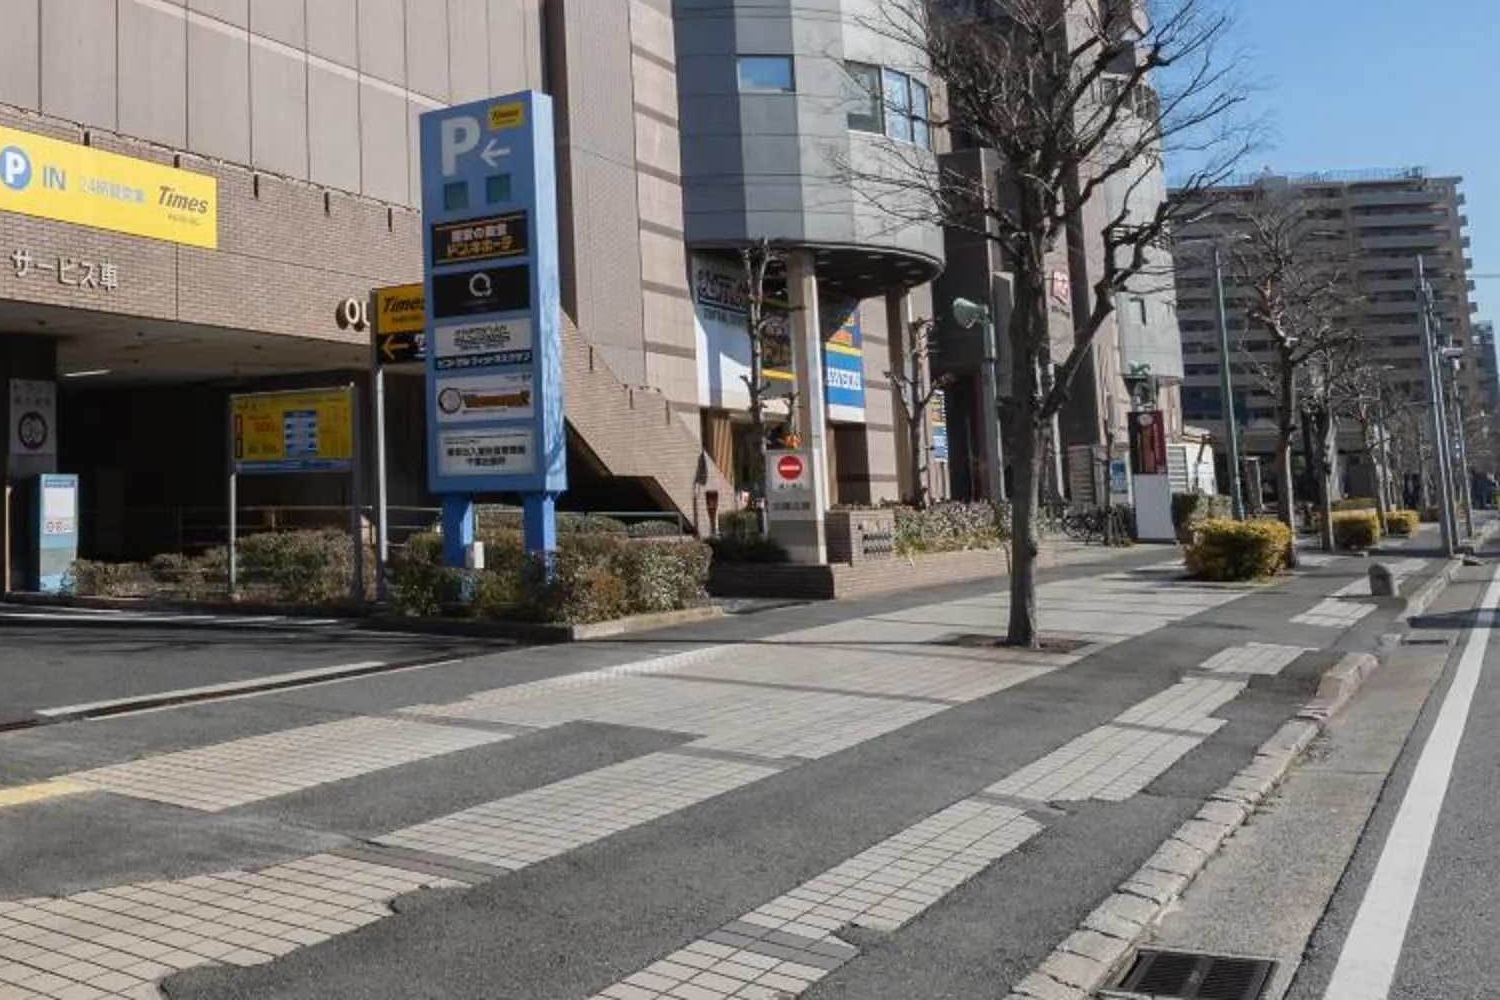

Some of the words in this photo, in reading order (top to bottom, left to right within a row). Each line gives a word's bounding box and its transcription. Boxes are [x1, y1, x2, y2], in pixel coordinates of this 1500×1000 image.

[442, 116, 481, 177] P
[42, 165, 67, 192] IN
[158, 186, 209, 215] Times
[10, 249, 118, 291] サービス車
